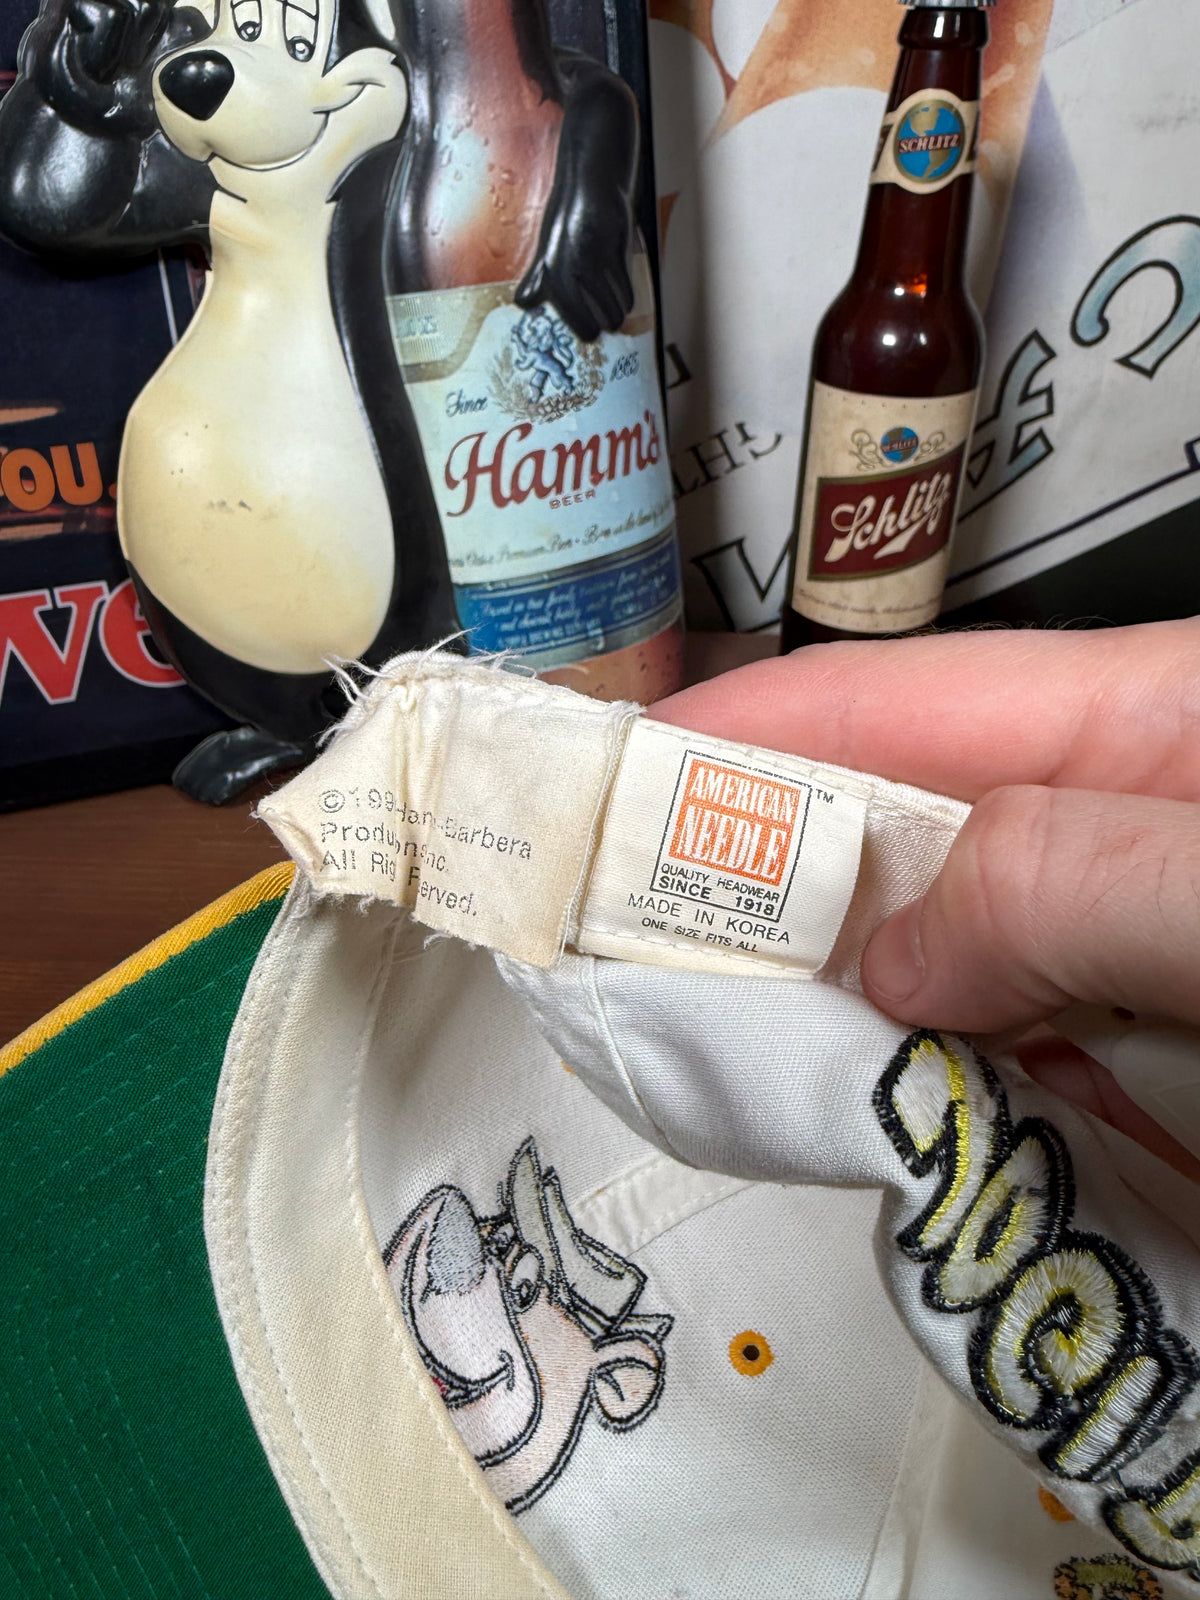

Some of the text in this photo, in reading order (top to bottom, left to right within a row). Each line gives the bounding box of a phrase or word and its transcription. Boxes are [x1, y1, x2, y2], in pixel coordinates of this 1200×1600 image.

[899, 134, 959, 153] SCHLITZ
[445, 389, 488, 417] Since
[0, 441, 117, 512] OU.
[445, 409, 660, 517] Hamm's
[549, 489, 596, 509] BEER
[823, 471, 952, 563] Schlitz
[690, 766, 798, 825] AMERICAN
[815, 788, 834, 804] TM
[319, 849, 356, 873] All
[677, 805, 787, 880] NEEDLE
[659, 876, 776, 917] SINCE 1918
[661, 863, 780, 903] QUALITY HEADWEAR
[628, 893, 790, 944] MADE IN KOREA
[641, 917, 759, 953] ONE SIZE FITS ALL
